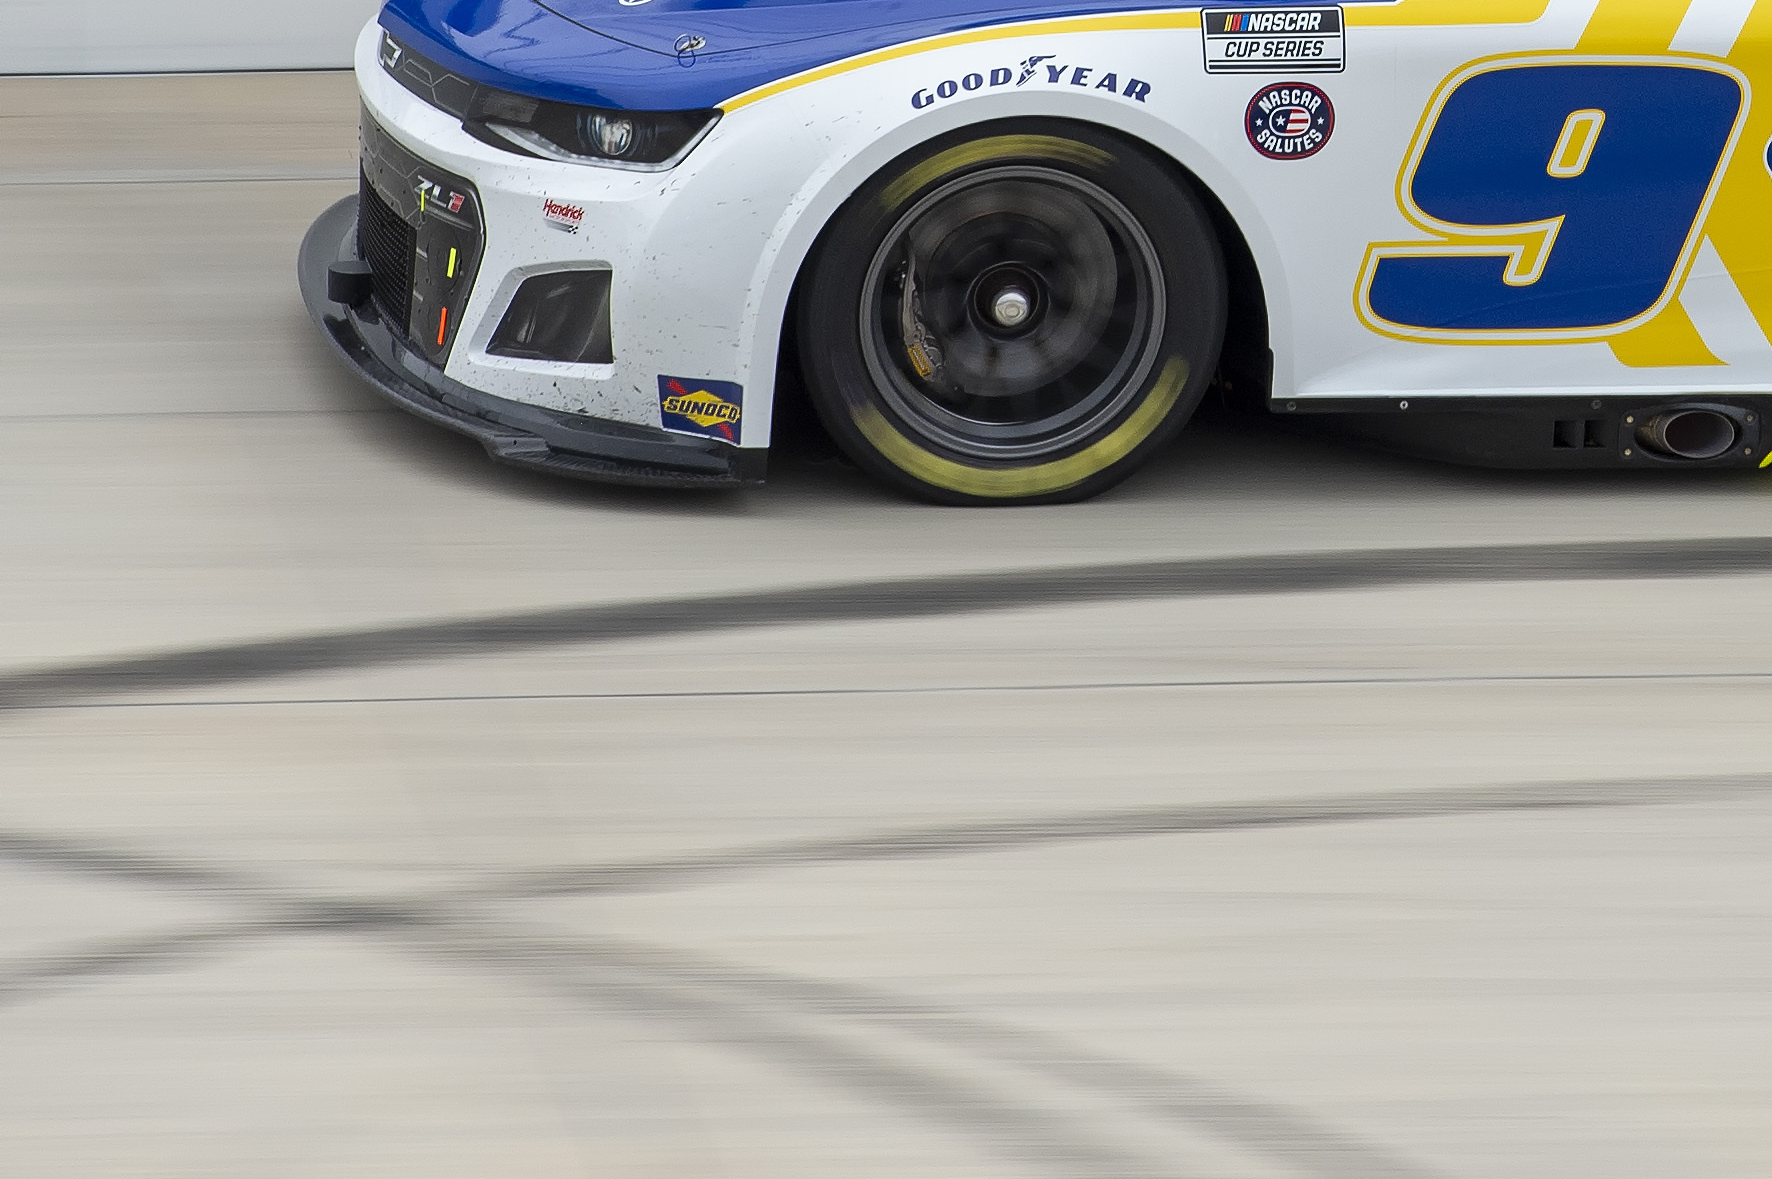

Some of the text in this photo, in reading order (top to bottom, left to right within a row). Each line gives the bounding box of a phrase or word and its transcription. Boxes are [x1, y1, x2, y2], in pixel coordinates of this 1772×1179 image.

[1248, 12, 1321, 32] NASCAR
[1225, 40, 1324, 57] CUP SERIES
[1258, 89, 1321, 114] NASCAR
[1257, 128, 1322, 152] SALUTES
[1354, 49, 1752, 344] 9
[543, 199, 584, 220] Hendrick
[667, 398, 739, 421] SUNOCO
